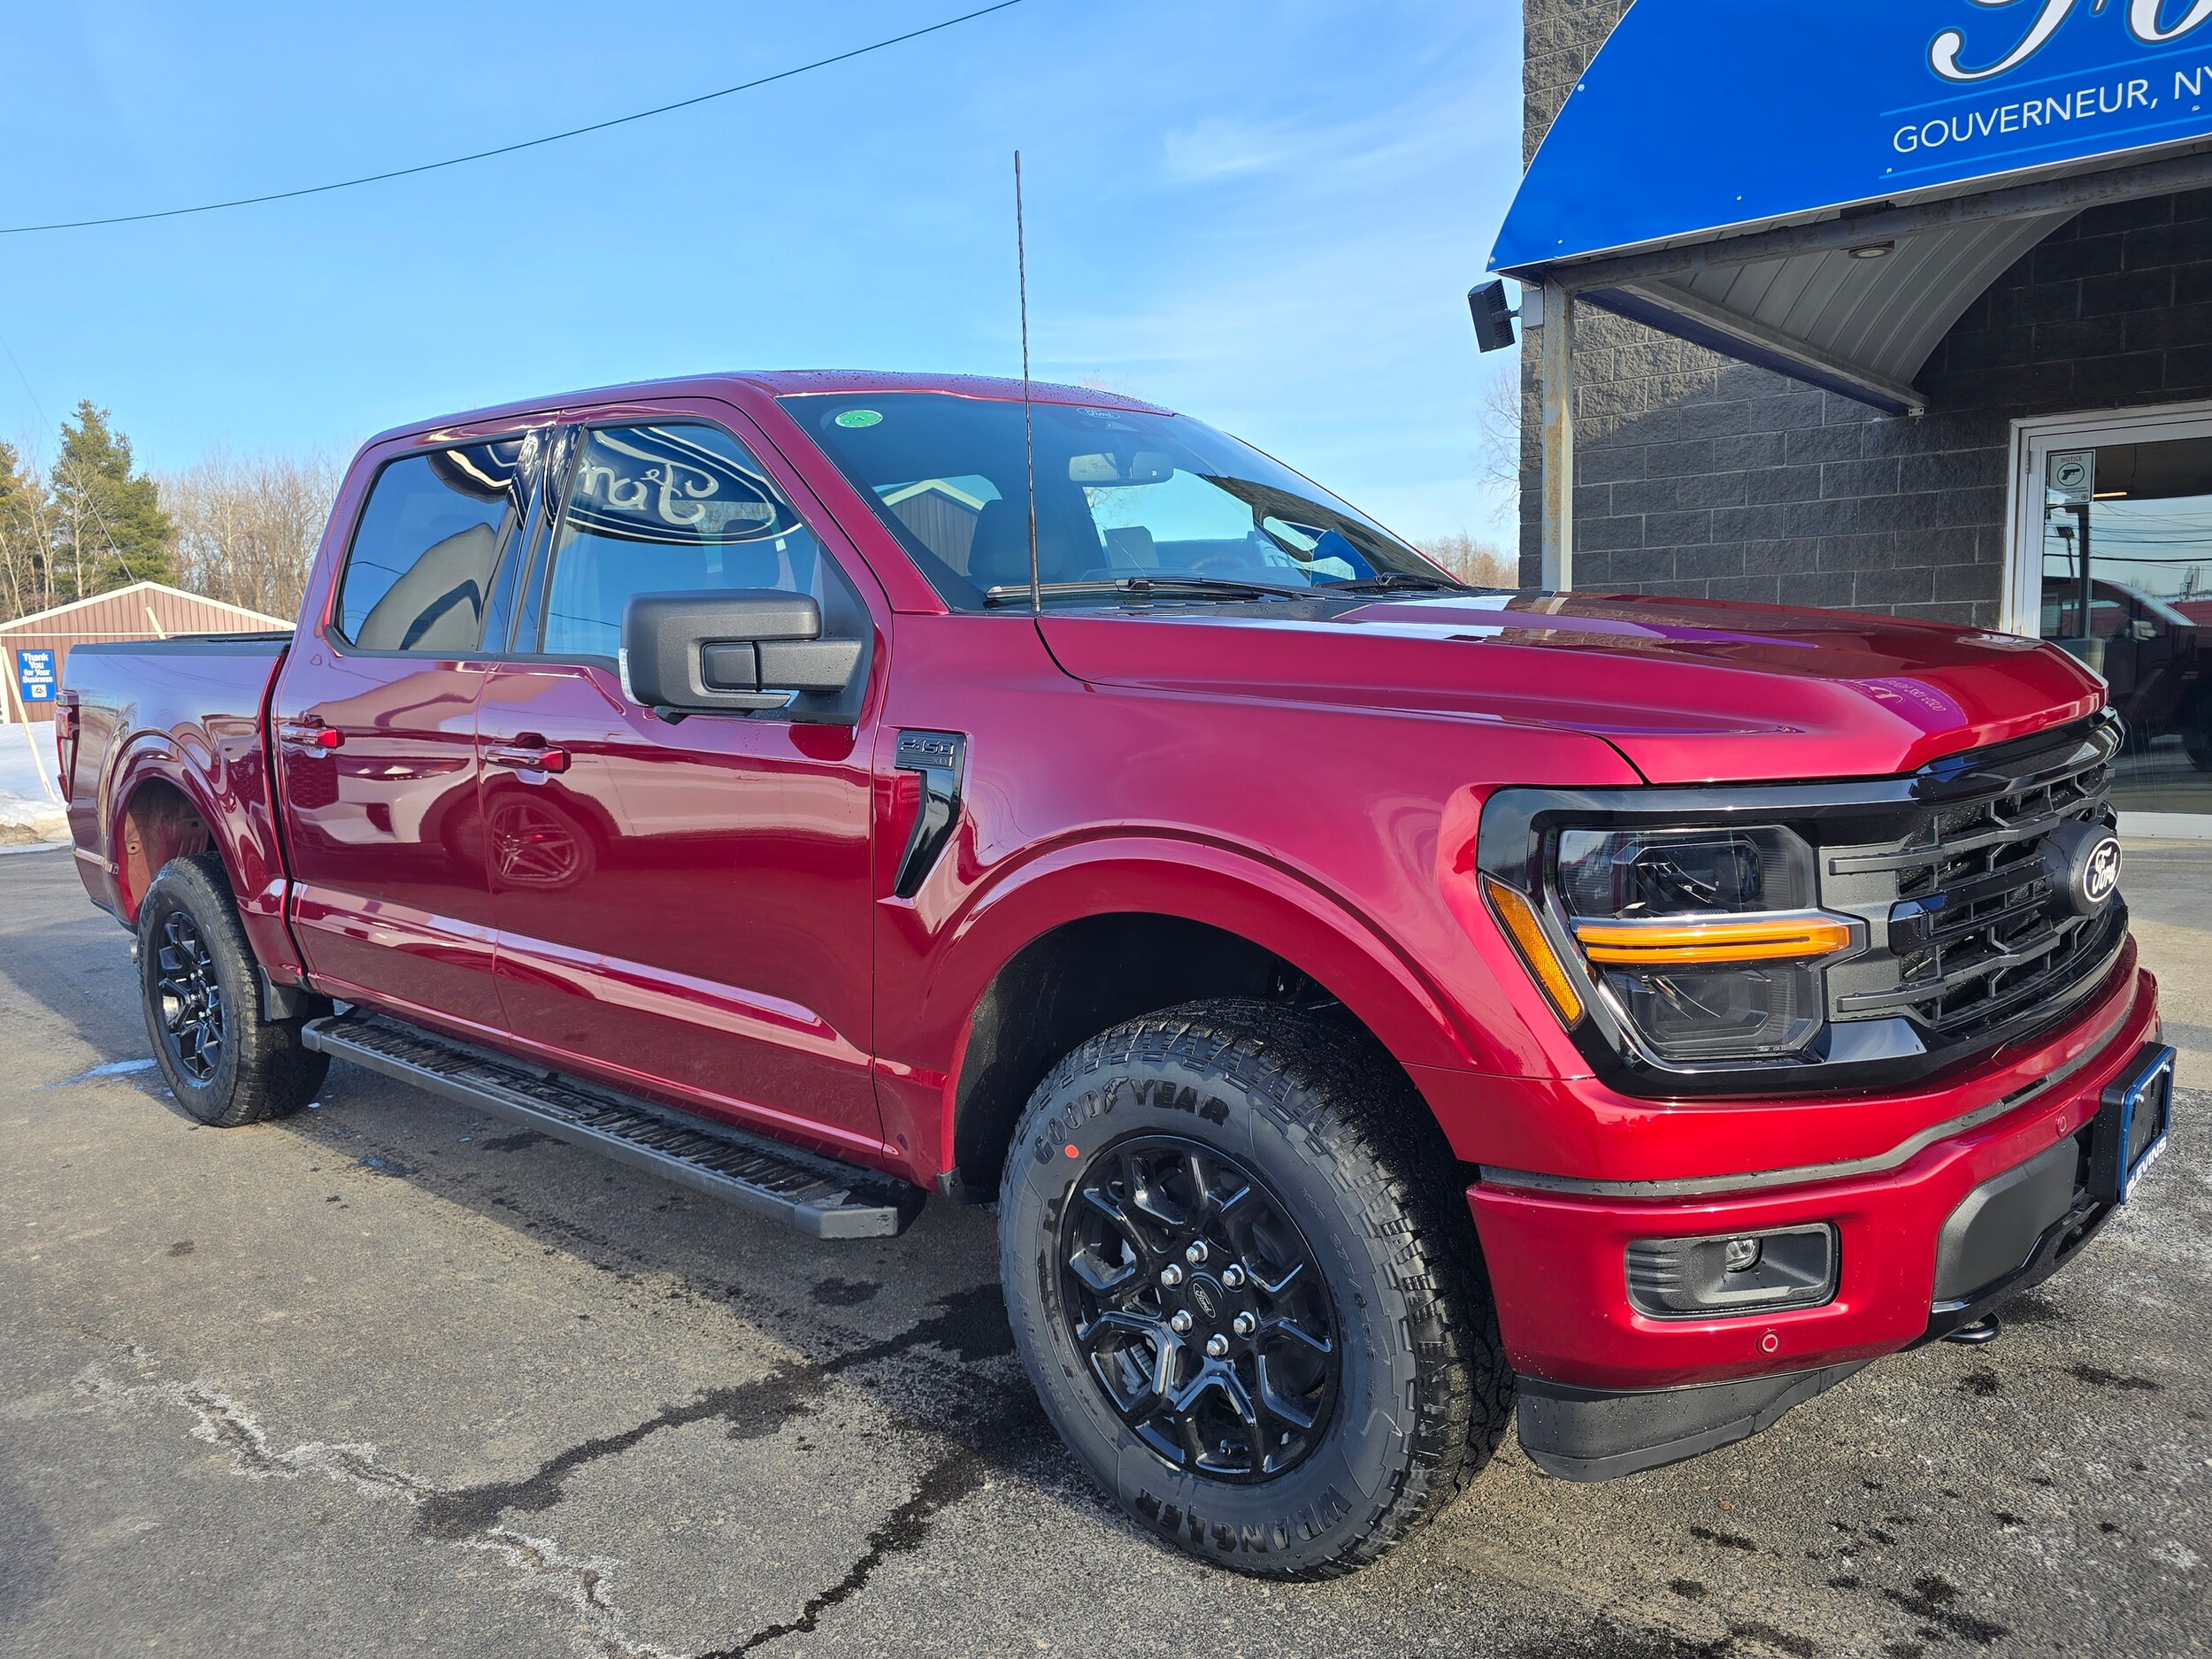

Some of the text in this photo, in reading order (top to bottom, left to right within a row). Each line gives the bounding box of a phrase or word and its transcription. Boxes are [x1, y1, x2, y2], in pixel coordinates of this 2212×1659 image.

[1893, 79, 2158, 153] GOUVERNEUR,
[22, 652, 49, 662] Thank
[2092, 847, 2117, 895] Ford
[2125, 1136, 2167, 1200] BLEVINS
[1135, 1483, 1353, 1553] WRANGLER
